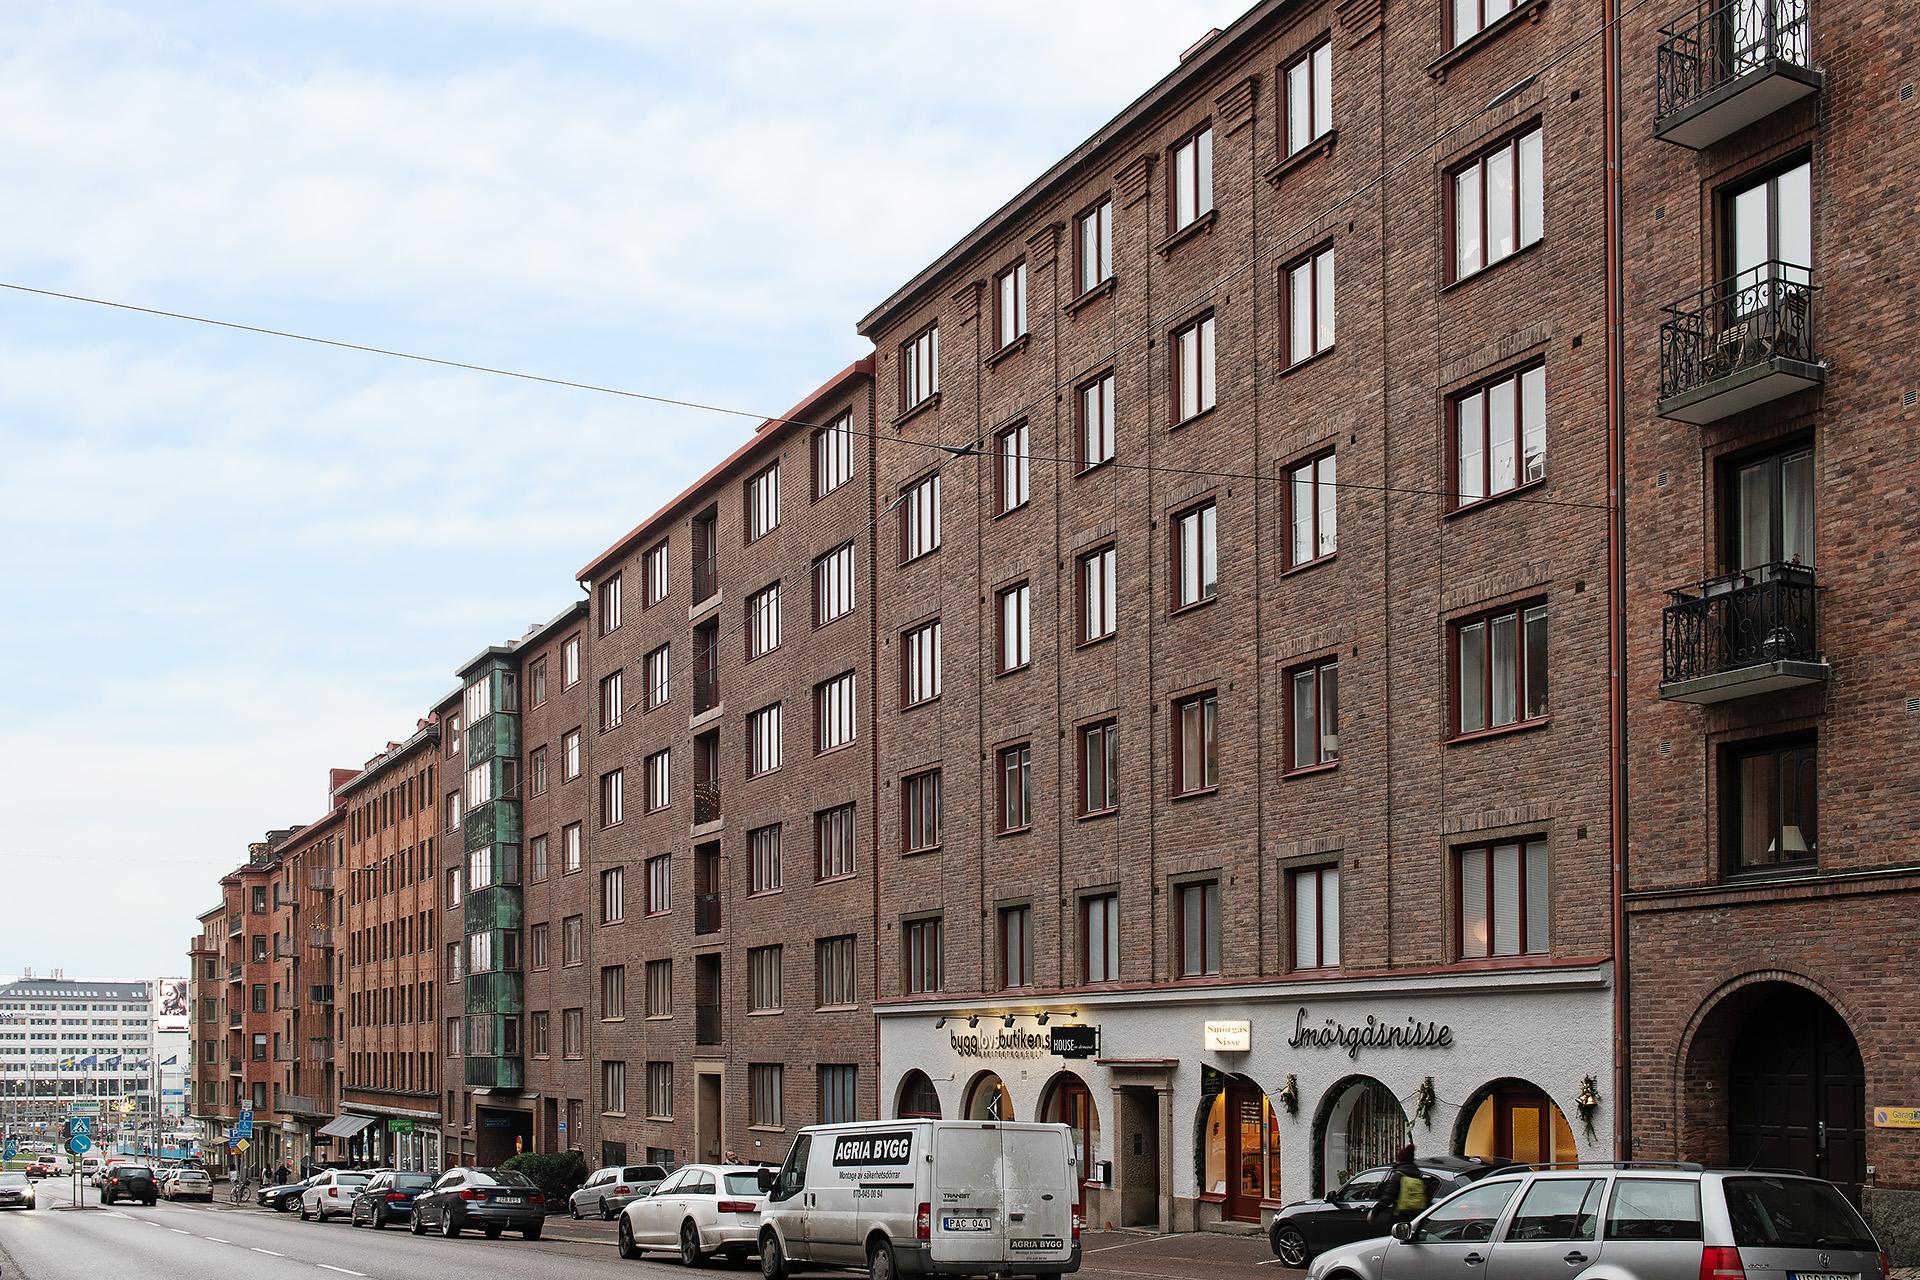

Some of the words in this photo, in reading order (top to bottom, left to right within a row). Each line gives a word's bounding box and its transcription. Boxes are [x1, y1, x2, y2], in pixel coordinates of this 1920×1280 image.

[1288, 1007, 1453, 1058] Smörgåsnisse
[950, 1027, 1051, 1056] bygglovsbutiken.s
[1053, 1039, 1075, 1051] HOUSE
[1215, 1037, 1241, 1046] Nisse
[243, 1112, 250, 1120] P
[835, 1140, 871, 1160] AGRIA
[873, 1138, 909, 1159] BYGG
[839, 1171, 857, 1181] Montage
[949, 1219, 967, 1228] PAC
[972, 1219, 989, 1228] 041
[1011, 1240, 1038, 1248] AGRIA
[1039, 1240, 1063, 1248] BYGG
